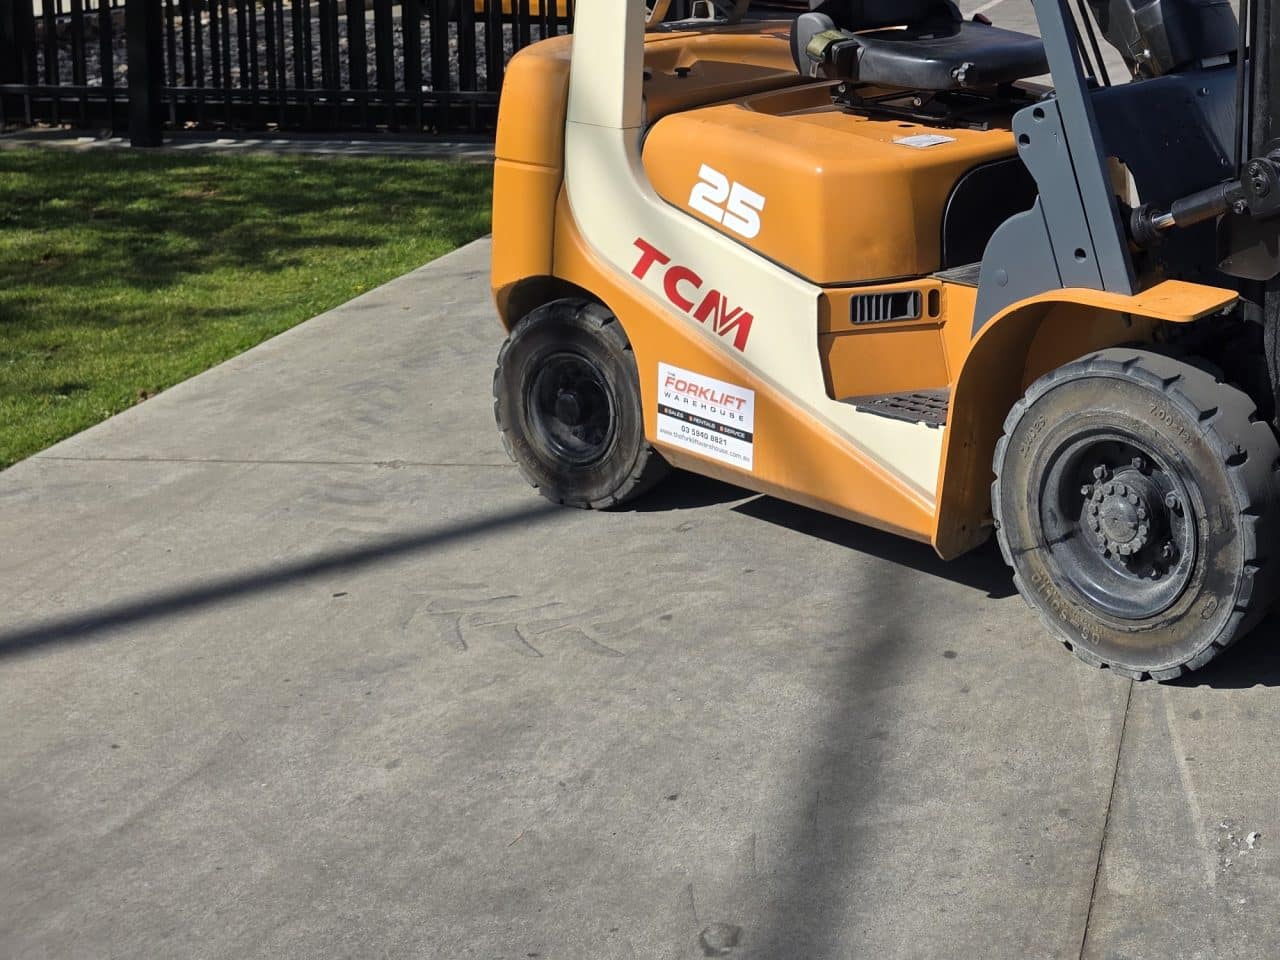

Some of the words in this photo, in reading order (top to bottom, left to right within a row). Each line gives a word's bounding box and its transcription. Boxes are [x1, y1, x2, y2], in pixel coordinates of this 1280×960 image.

[688, 163, 766, 239] 25
[631, 237, 755, 353] TCM
[664, 376, 747, 411] FORKLIFT
[664, 392, 744, 422] WAREHOUSE
[681, 425, 690, 434] 03
